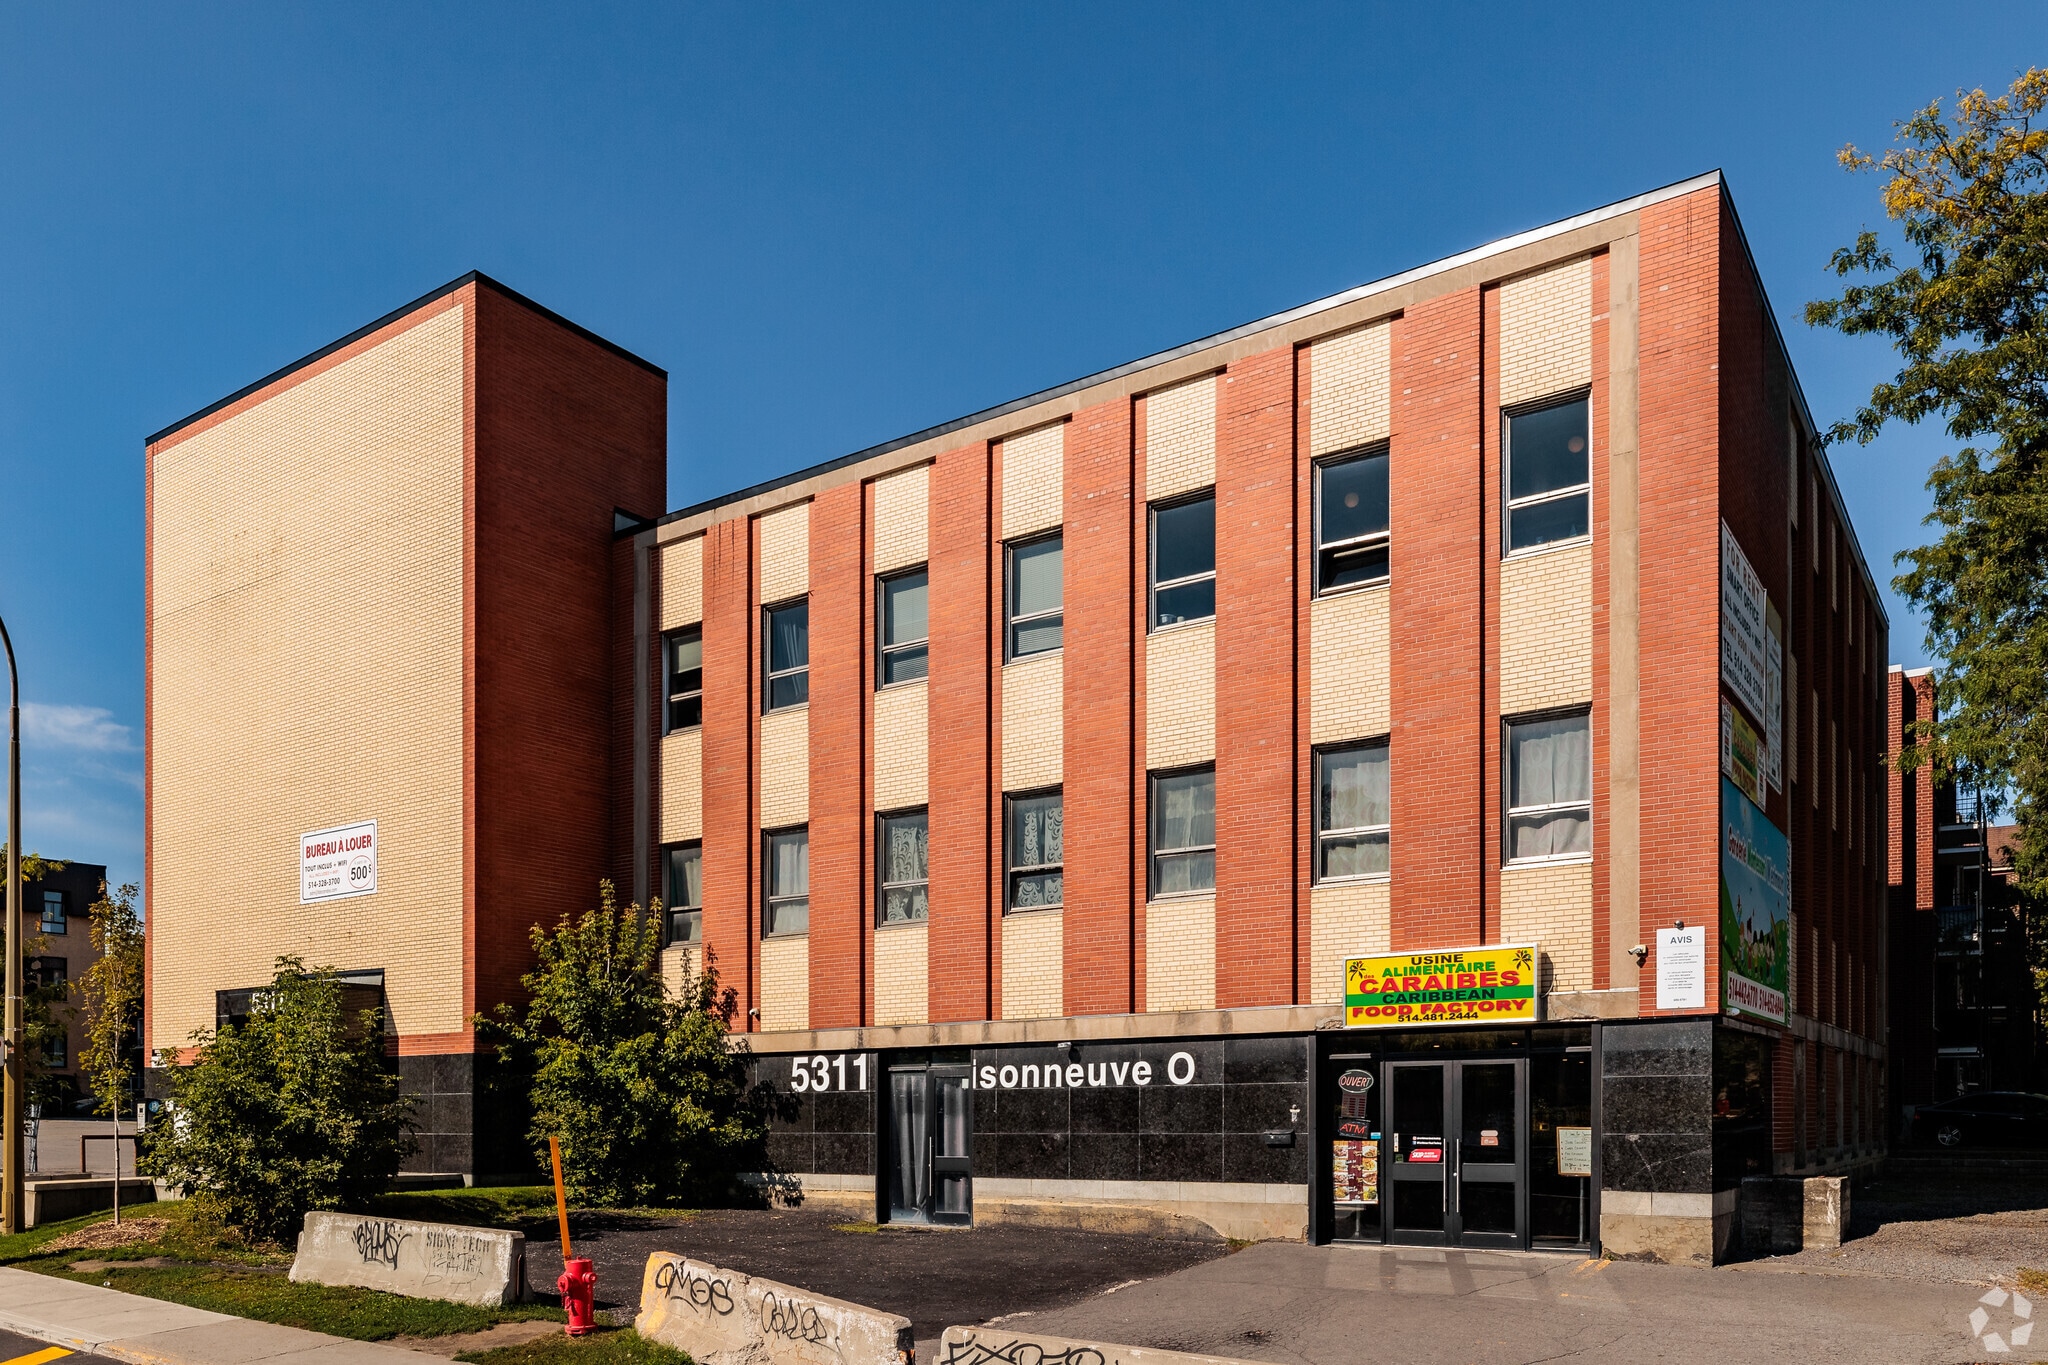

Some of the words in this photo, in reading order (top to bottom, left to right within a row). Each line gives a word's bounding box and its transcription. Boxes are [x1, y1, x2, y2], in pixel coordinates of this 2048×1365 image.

[1726, 538, 1740, 575] FOR
[1743, 565, 1760, 605] RENT
[1726, 564, 1742, 600] SMART
[1744, 591, 1759, 626] OFFICE
[1724, 636, 1732, 662] TEL
[306, 841, 336, 858] BUREAU
[338, 837, 344, 853] À
[346, 834, 372, 851] LOUER
[317, 862, 332, 870] INCLUS
[1670, 936, 1692, 944] AVIS
[1411, 954, 1464, 965] USINE
[1382, 961, 1496, 978] ALIMENTAIRE
[1360, 970, 1521, 994] CARAIBES
[1382, 989, 1495, 1004] CARIBBEAN
[1352, 1004, 1412, 1018] FOOD
[1420, 999, 1527, 1014] FACTORY
[1398, 1011, 1478, 1023] 514.481.2444
[790, 1054, 867, 1093] 5311
[1167, 1051, 1196, 1085] O
[1340, 1076, 1371, 1087] OUVERT
[1340, 1123, 1365, 1134] ATM
